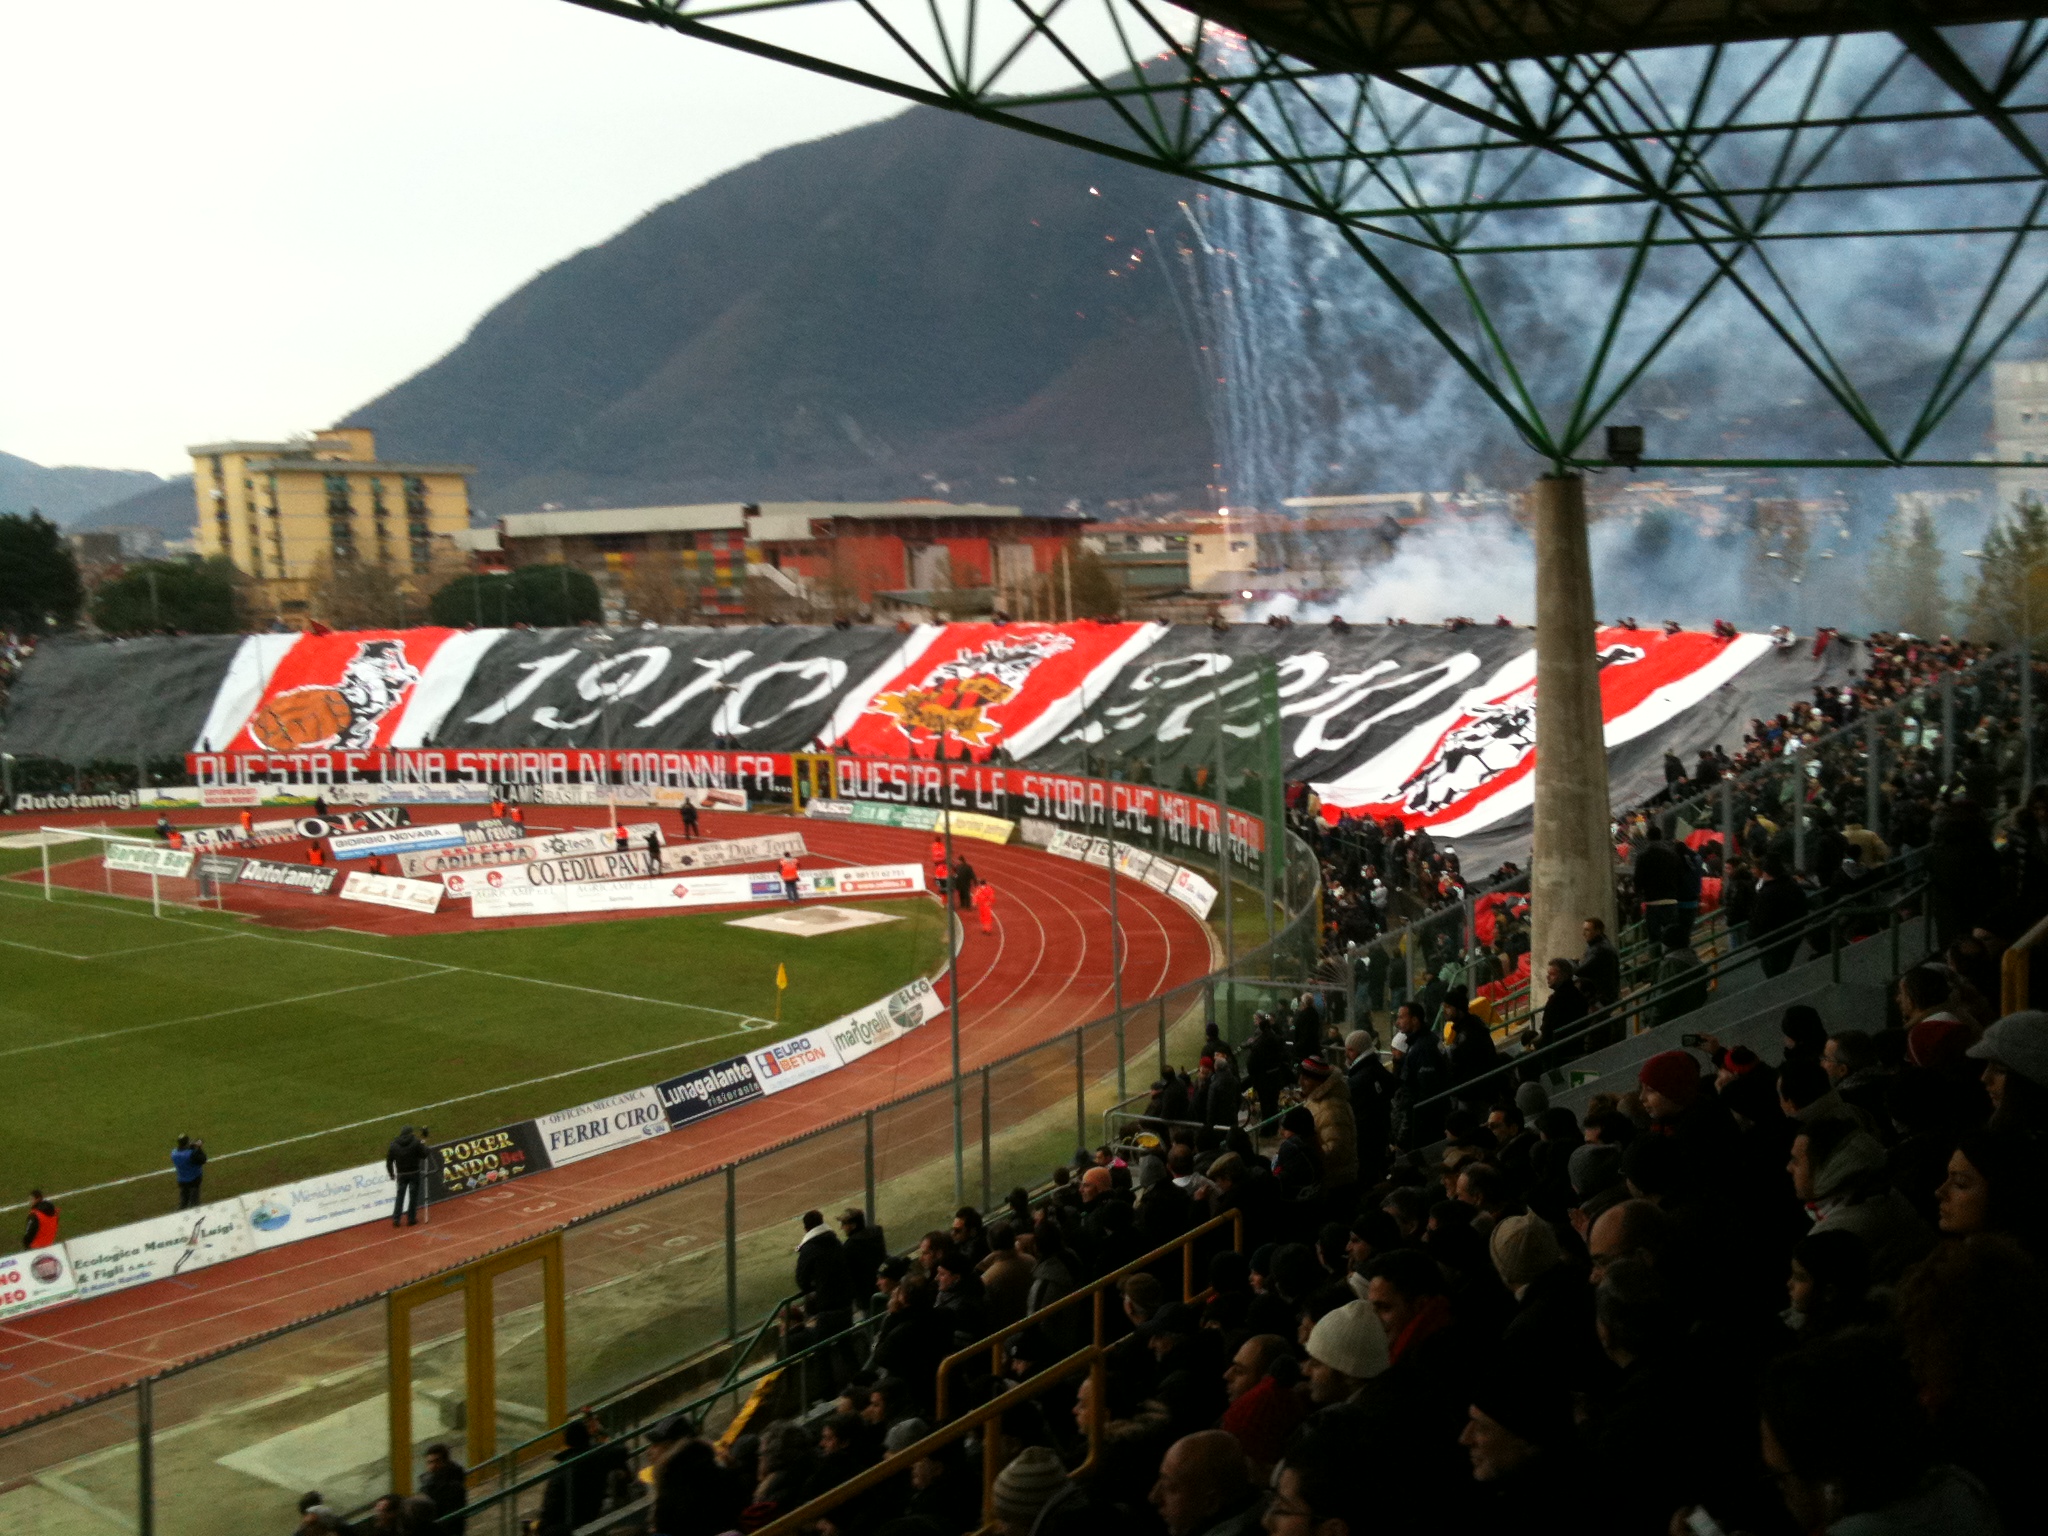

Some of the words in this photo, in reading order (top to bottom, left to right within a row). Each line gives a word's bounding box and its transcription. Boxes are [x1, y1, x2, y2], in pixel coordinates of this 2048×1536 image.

[468, 645, 848, 736] 1910
[196, 754, 334, 786] QUESTA
[381, 752, 447, 785] UNA
[457, 752, 568, 785] STORIA
[577, 753, 609, 786] DI
[838, 760, 943, 804] QUESTA
[15, 789, 139, 811] Autotamigi
[389, 828, 442, 842] NOVARA
[239, 859, 338, 893] Autotamigi
[773, 1037, 812, 1060] EURO
[778, 1046, 826, 1072] BETON
[592, 1090, 645, 1112] MECCANICA
[657, 1060, 752, 1108] Lunagalante
[549, 1117, 609, 1151] FERRI
[614, 1102, 660, 1131] CIRO
[440, 1131, 515, 1165] POKER
[442, 1153, 499, 1184] ANDO
[74, 1248, 140, 1270] Ecologica
[144, 1236, 189, 1252] Manzo
[200, 1222, 234, 1239] Luigi
[93, 1264, 125, 1280] Figli
